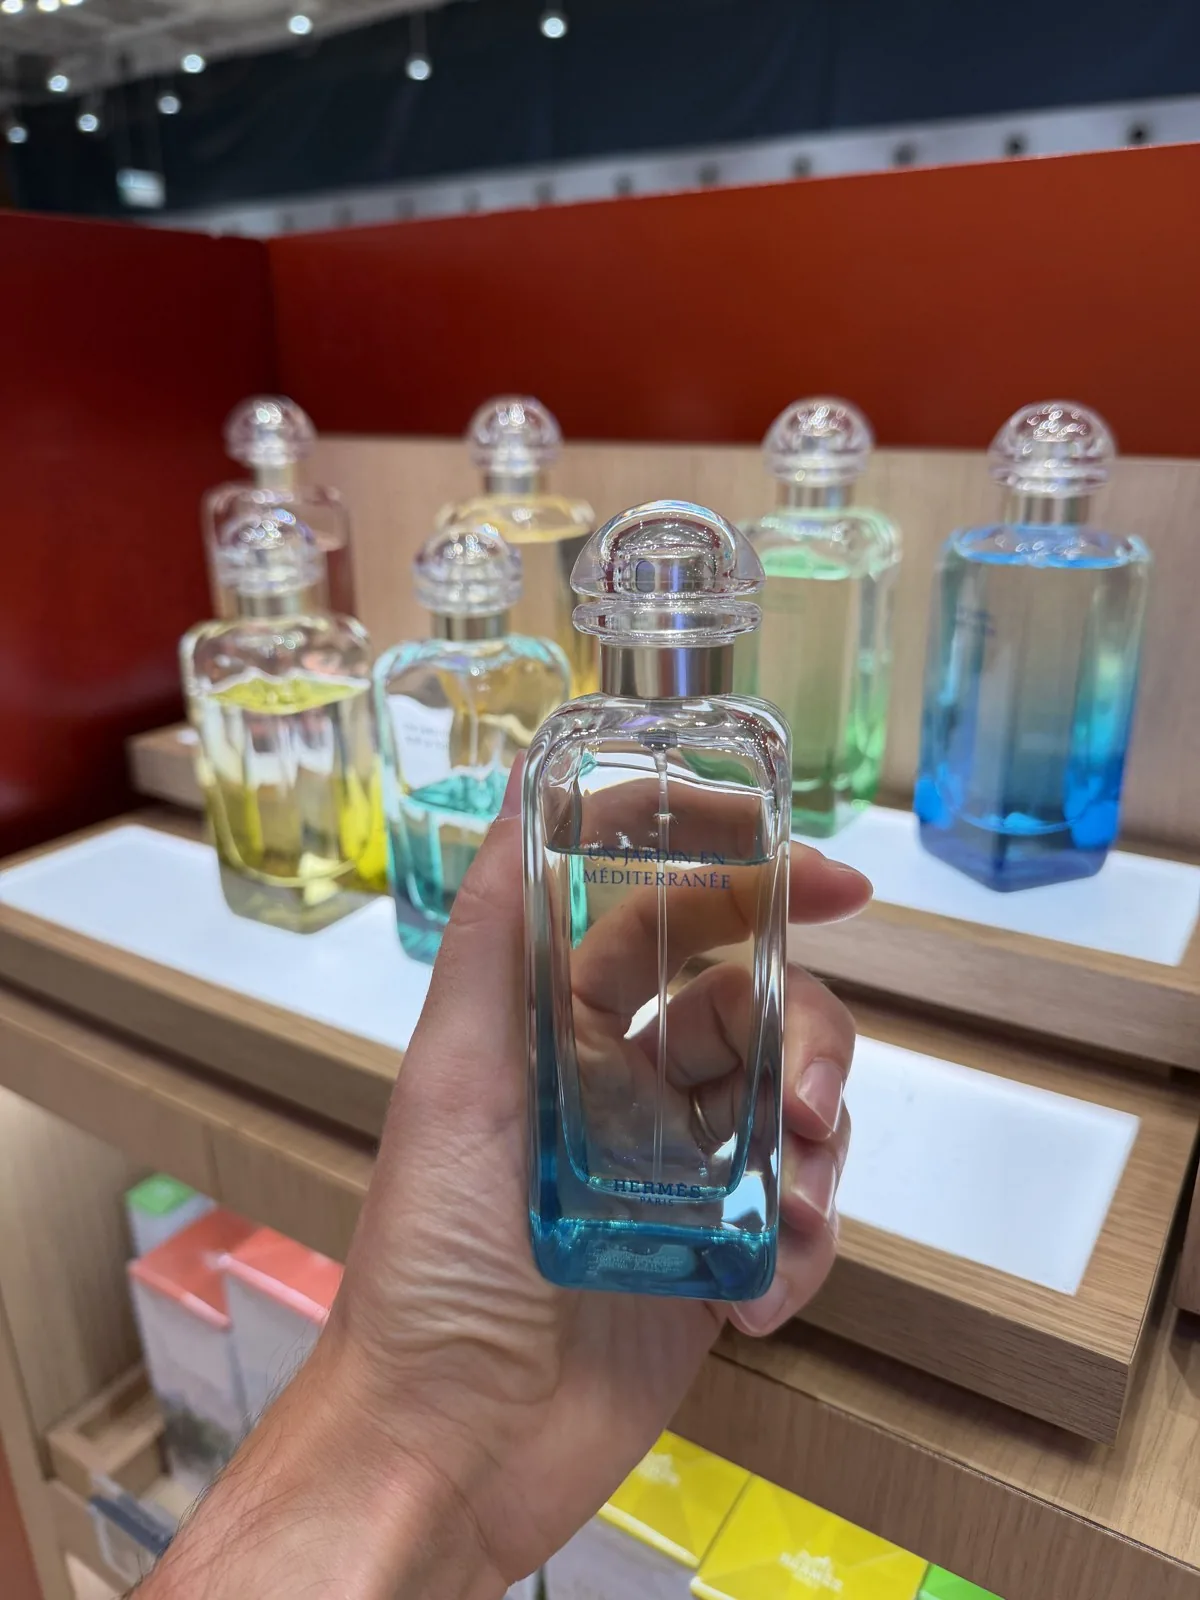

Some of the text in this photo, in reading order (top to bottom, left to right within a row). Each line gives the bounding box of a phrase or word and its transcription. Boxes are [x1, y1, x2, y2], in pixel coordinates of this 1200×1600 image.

[587, 847, 725, 867] UN JARDIN EN
[583, 867, 731, 889] MÉDITERRANÉE
[640, 1196, 675, 1207] PARIS
